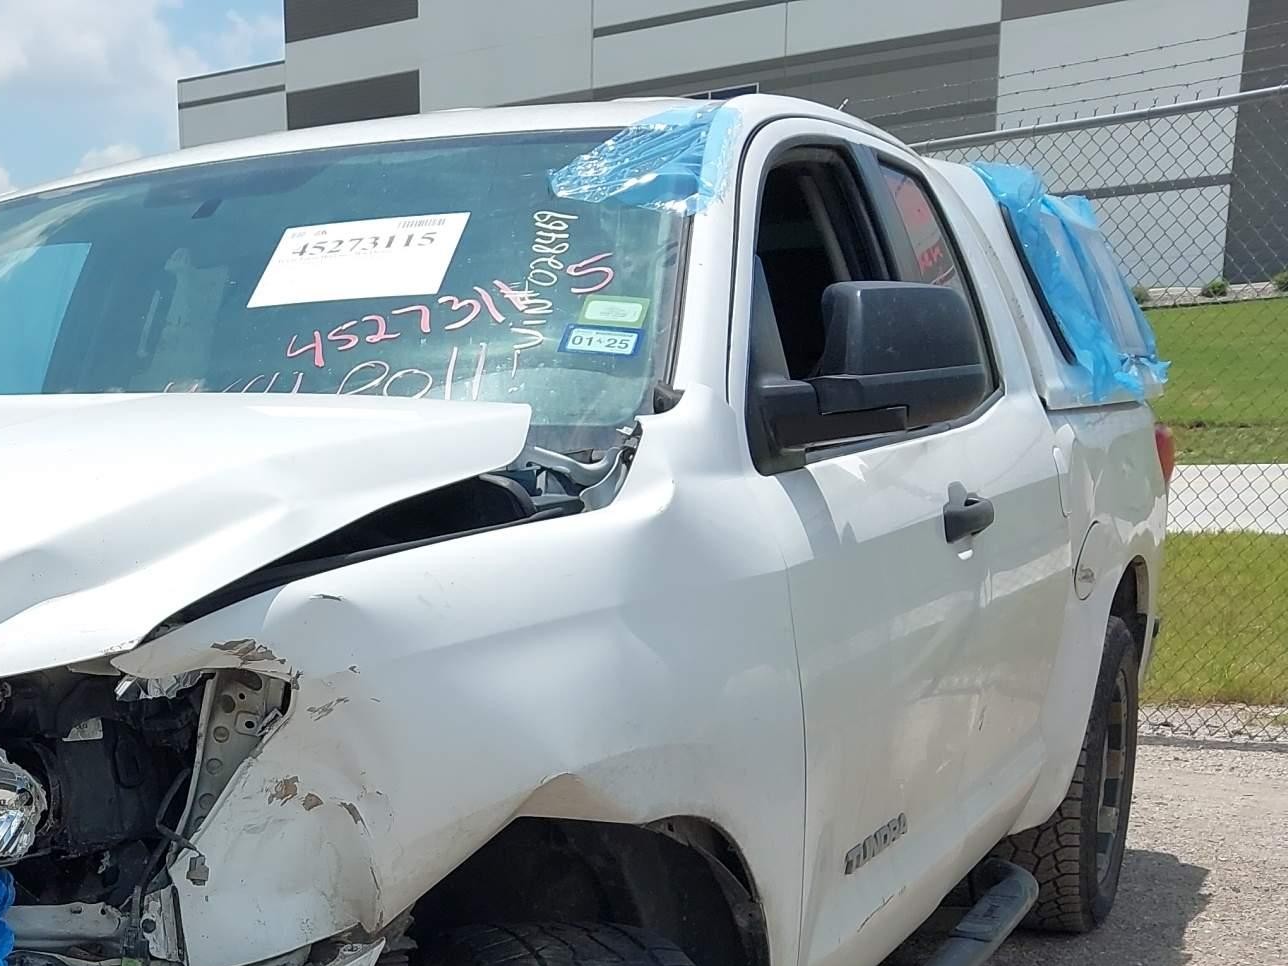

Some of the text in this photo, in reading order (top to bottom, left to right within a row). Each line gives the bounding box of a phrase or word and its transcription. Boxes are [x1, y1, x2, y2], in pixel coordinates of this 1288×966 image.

[292, 232, 437, 257] 45273115
[572, 335, 630, 350] 01 25
[844, 812, 909, 875] TUNDRA
